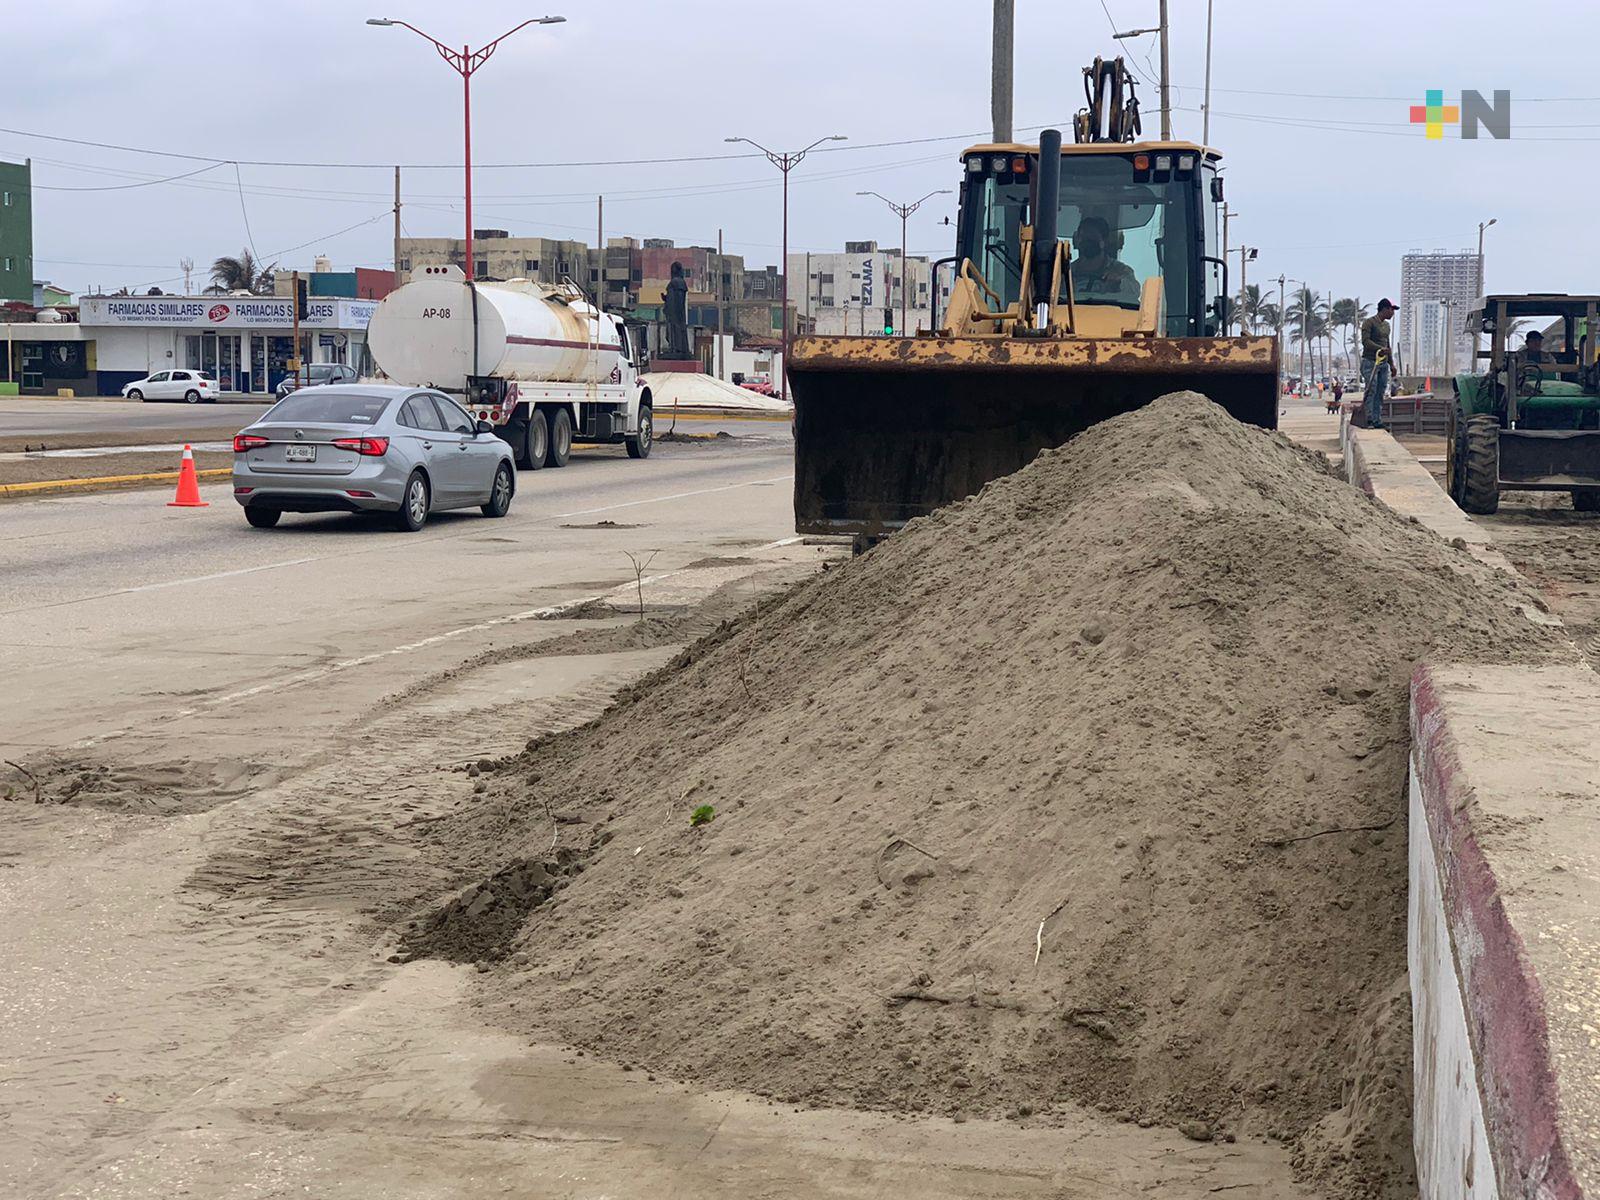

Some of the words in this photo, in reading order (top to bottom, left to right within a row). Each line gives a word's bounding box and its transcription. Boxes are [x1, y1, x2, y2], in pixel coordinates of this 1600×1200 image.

[108, 303, 156, 315] FARMACIAS
[158, 303, 204, 316] SIMILARES
[235, 304, 285, 316] FARMACIAS
[287, 305, 334, 317] SARES
[422, 308, 451, 319] AP-08
